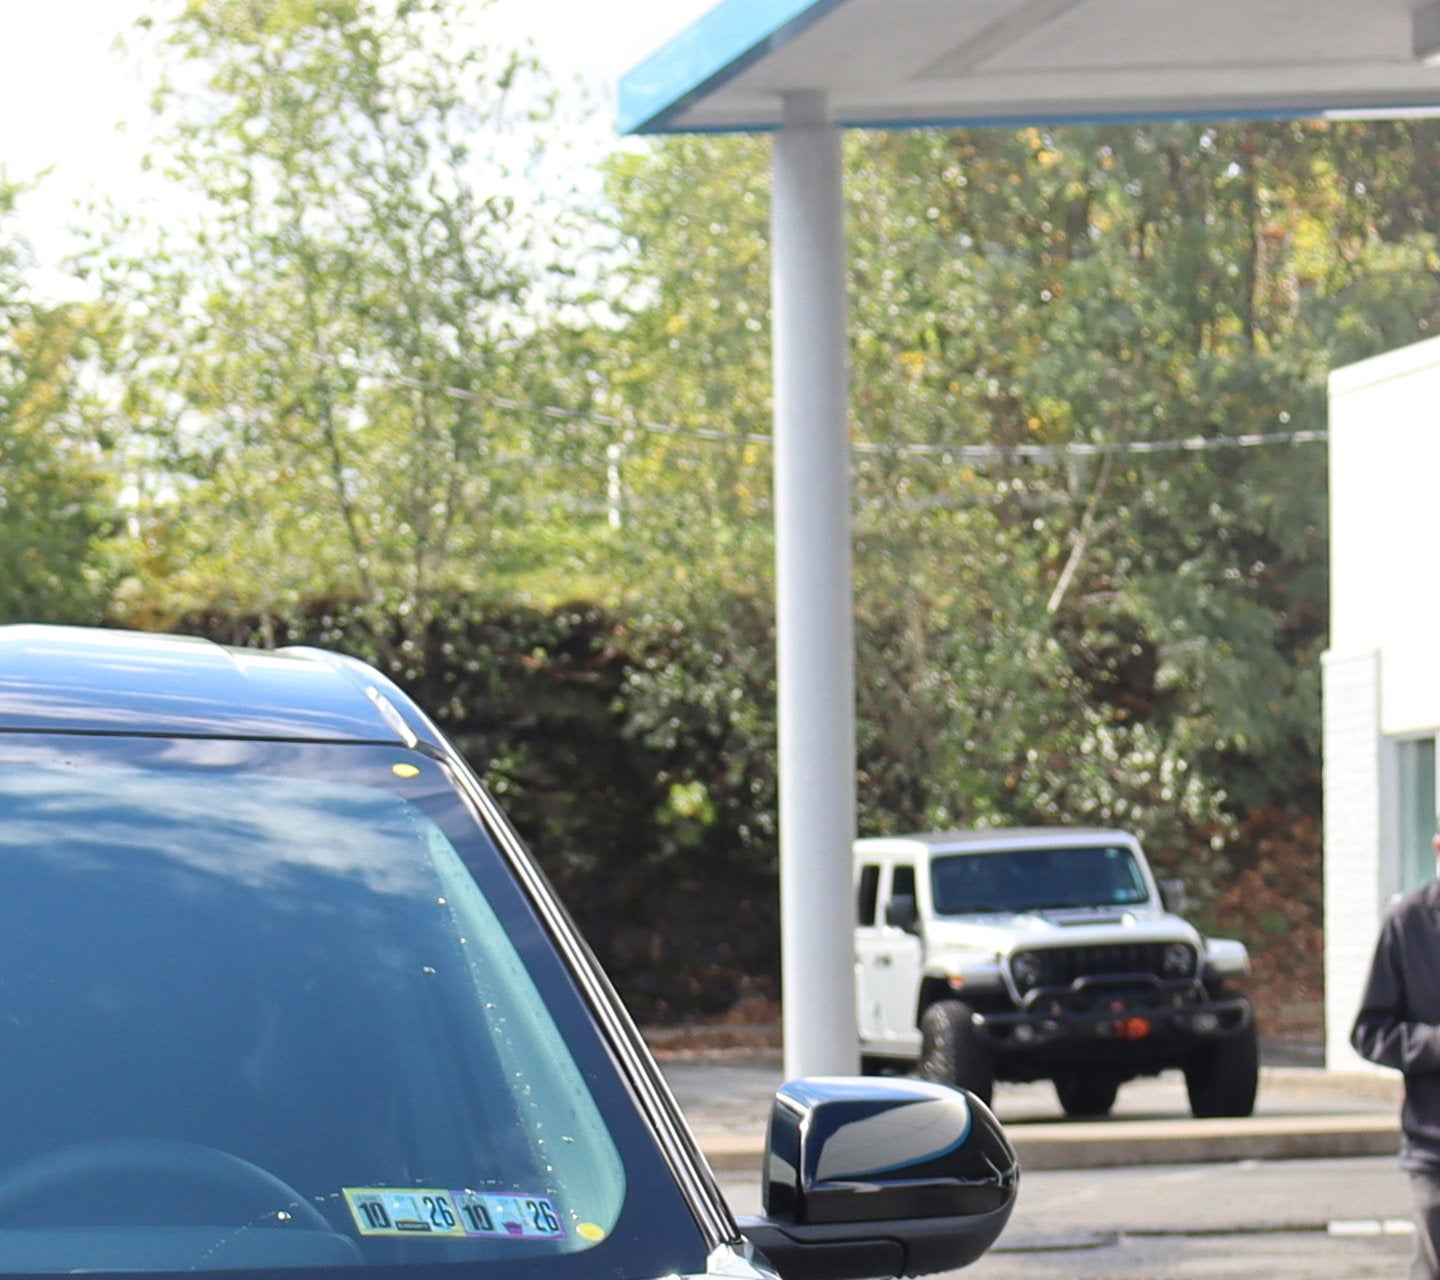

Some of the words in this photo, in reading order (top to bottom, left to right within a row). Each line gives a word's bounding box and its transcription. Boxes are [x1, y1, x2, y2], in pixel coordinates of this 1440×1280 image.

[358, 1201, 392, 1229] 10
[423, 1195, 456, 1227] 26
[463, 1203, 495, 1231] 10
[527, 1200, 560, 1232] 26
